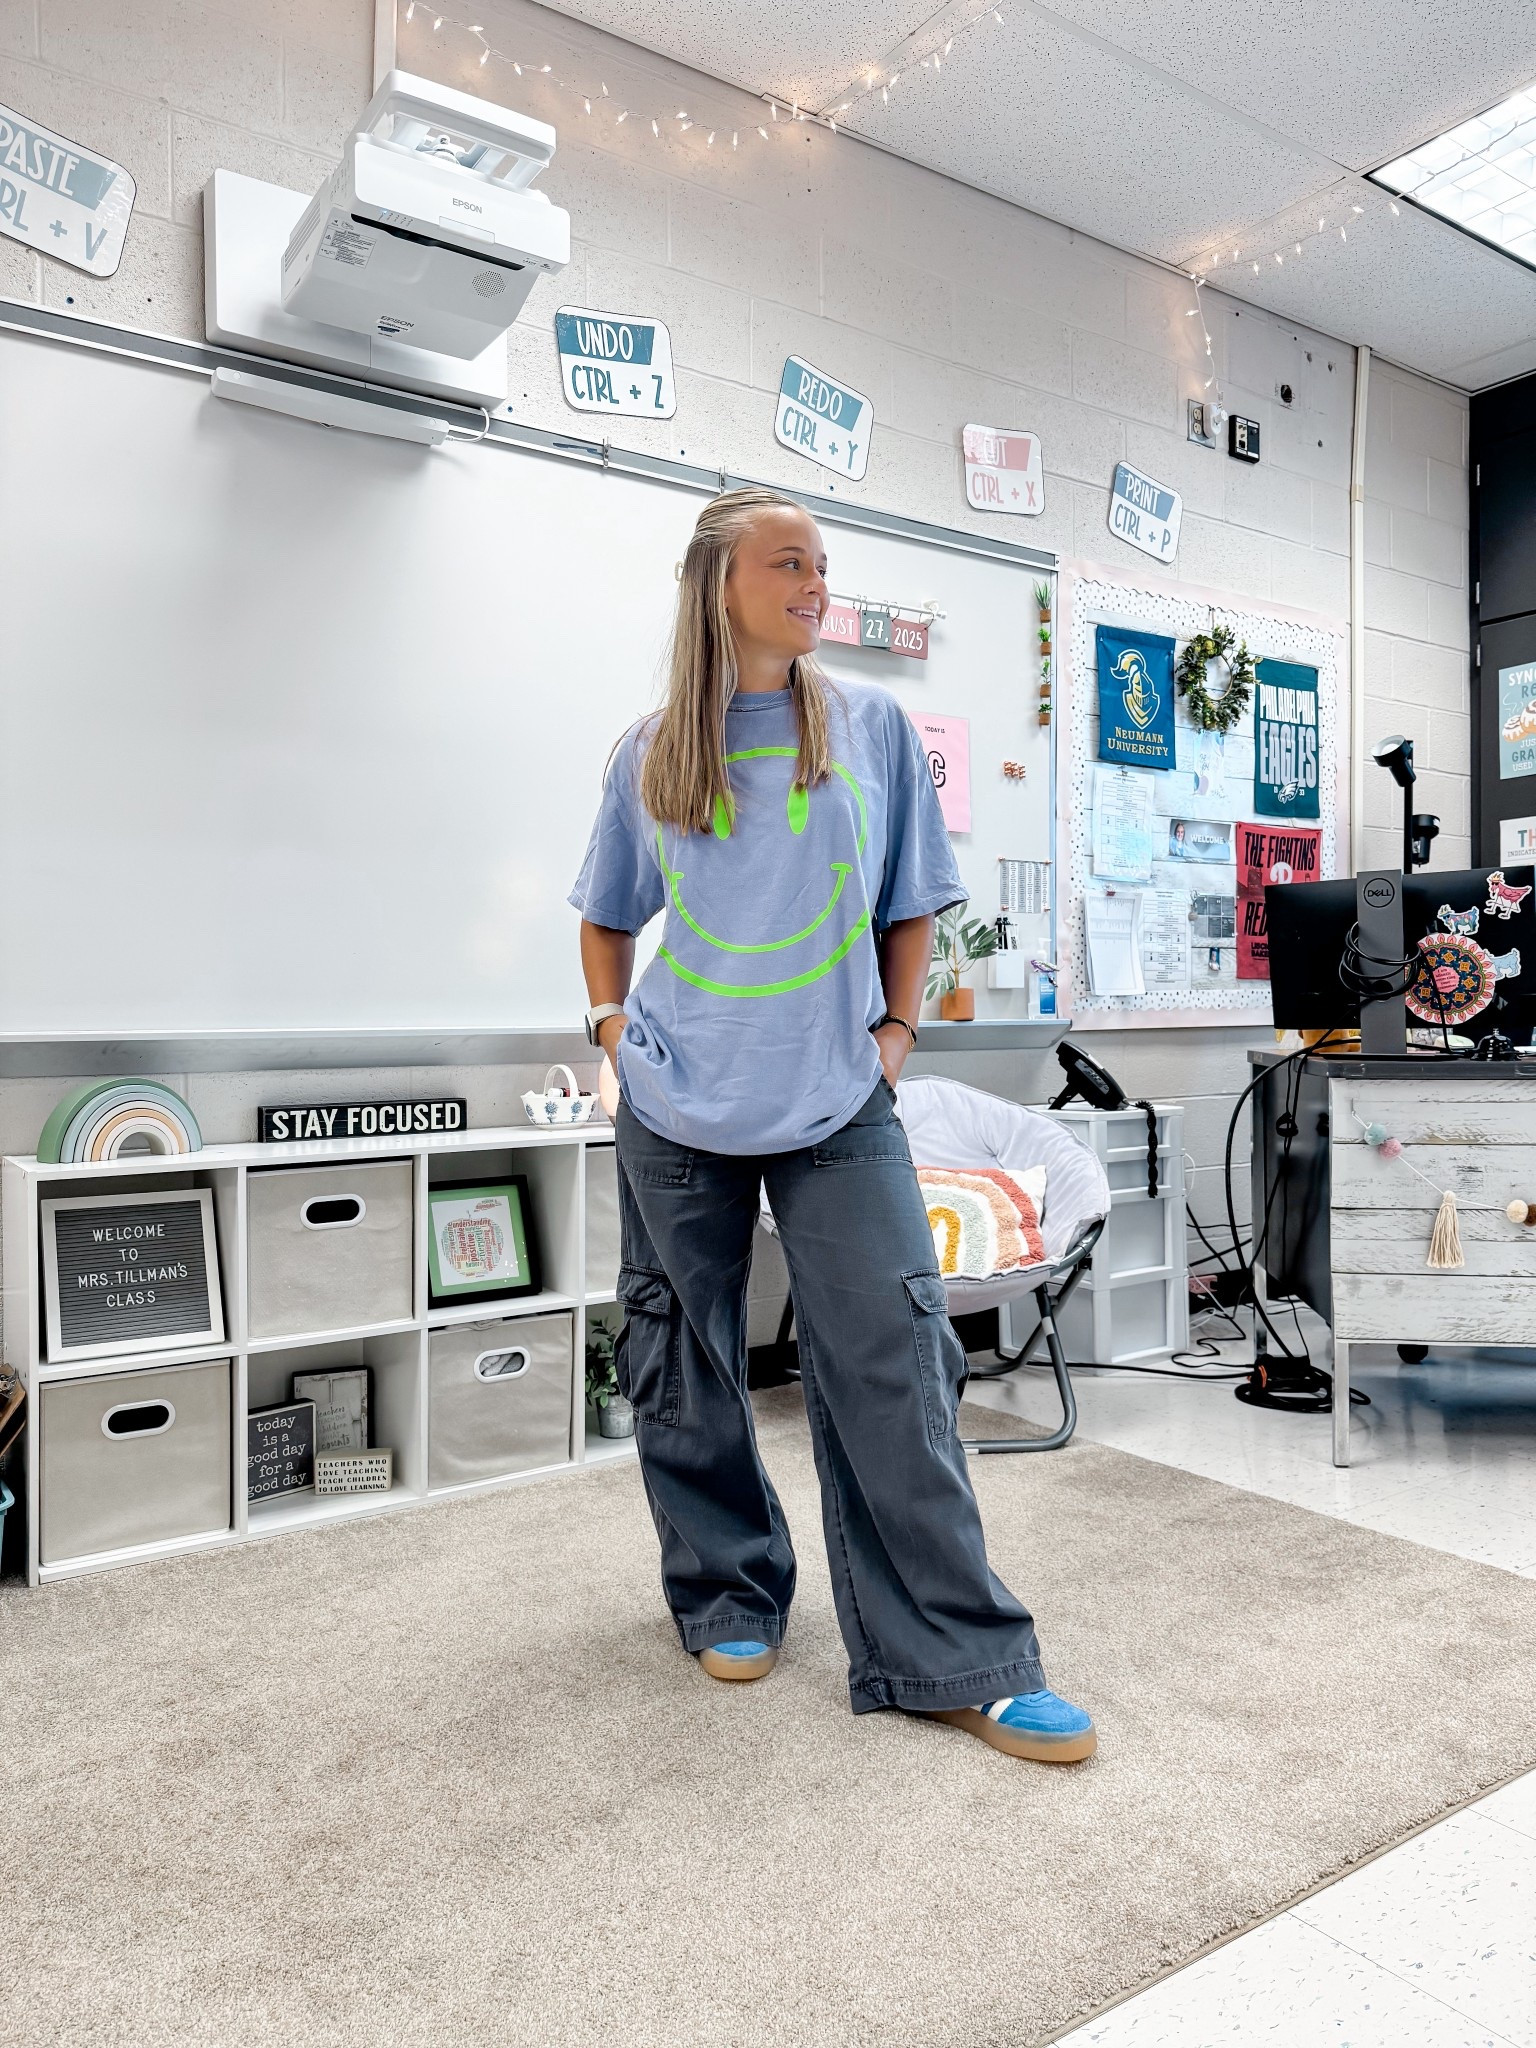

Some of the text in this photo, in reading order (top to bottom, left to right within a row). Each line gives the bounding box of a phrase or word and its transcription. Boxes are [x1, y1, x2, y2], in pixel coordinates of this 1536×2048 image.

[452, 197, 482, 214] EPSON
[0, 177, 108, 261] RL + V
[380, 315, 415, 327] EPSON
[576, 320, 633, 361] UNDO
[571, 364, 665, 409] CTRL + Z
[797, 370, 843, 421] REDO
[782, 406, 858, 470] CTRL + Y
[972, 471, 1036, 507] CTRL + X
[1124, 474, 1160, 515] PRINT
[1114, 504, 1171, 553] CTRL + P
[822, 614, 923, 650] GUST 27. 2025
[1259, 683, 1316, 726] PHILADELPHIA
[1114, 726, 1164, 744] NEUMANN
[1520, 738, 1536, 748] JUS
[1106, 737, 1169, 757] UNIVERSITY
[1259, 720, 1316, 788] EAGLES
[1512, 748, 1536, 762] GRA
[927, 750, 946, 788] C
[1512, 761, 1533, 771] USED
[1190, 833, 1225, 845] WELCOME
[1244, 831, 1317, 871] THE FIGHTINS
[1507, 848, 1536, 857] INDICATE
[1368, 888, 1391, 897] DELL
[272, 1102, 461, 1139] STAY FOCUSED
[452, 1219, 491, 1228] understanding
[93, 1224, 165, 1242] WELCOME
[119, 1248, 138, 1262] TO
[465, 1233, 479, 1262] positive
[106, 1290, 155, 1307] CLASS
[257, 1416, 296, 1432] today
[263, 1433, 290, 1447] is a
[248, 1443, 306, 1468] good day
[318, 1460, 363, 1468] TEACHERS
[259, 1461, 294, 1478] for a
[343, 1467, 387, 1475] TEACHING,
[248, 1473, 306, 1498] good day
[347, 1475, 387, 1483] CHILDREN
[350, 1483, 387, 1491] LEARNING.
